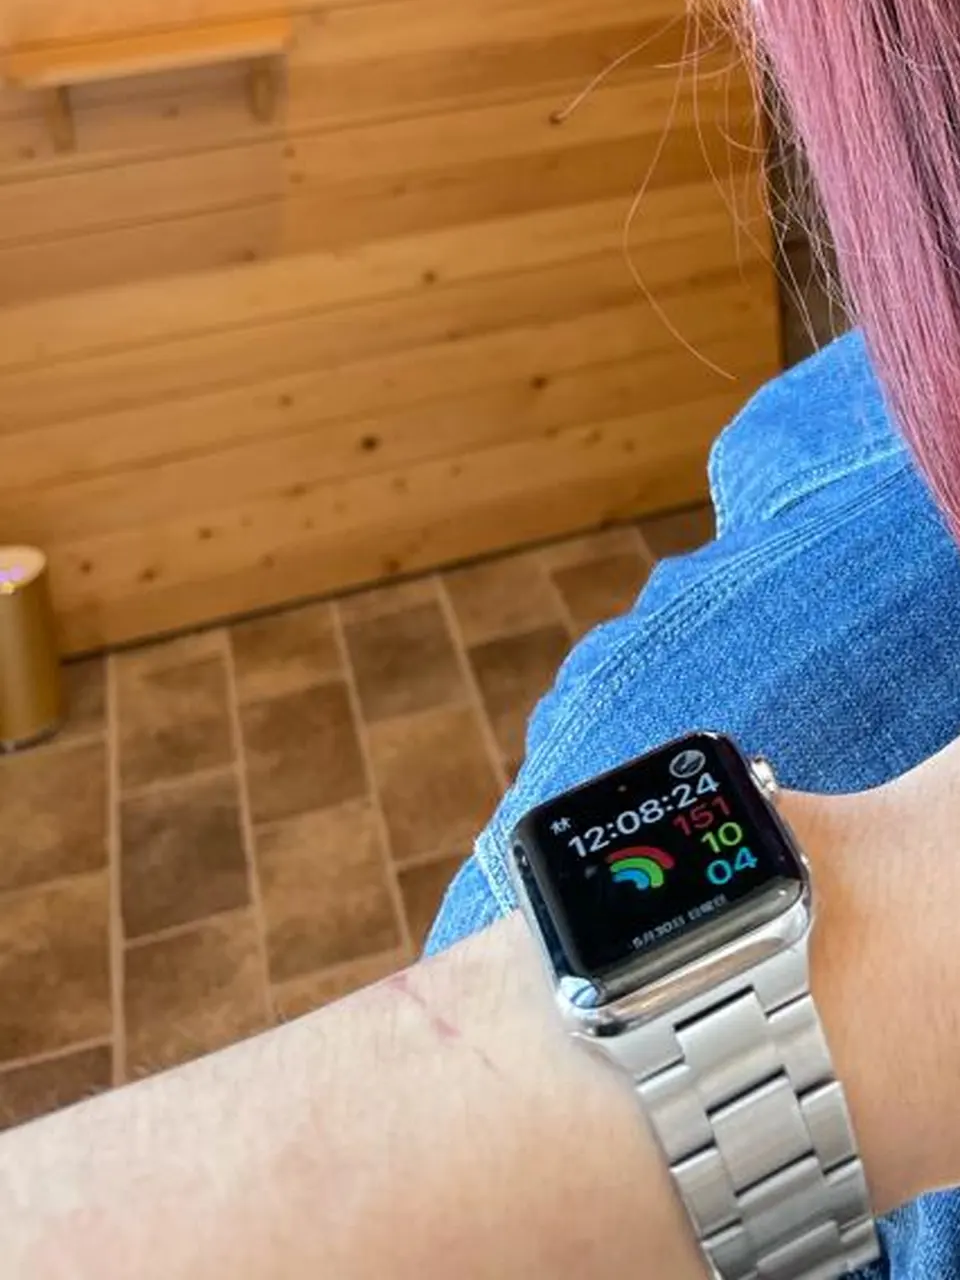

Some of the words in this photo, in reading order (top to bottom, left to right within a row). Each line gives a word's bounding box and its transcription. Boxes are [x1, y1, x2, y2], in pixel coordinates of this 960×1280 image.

[568, 772, 720, 857] 12:08:24
[673, 796, 730, 836] 151
[701, 822, 742, 853] 10
[706, 847, 758, 885] 04
